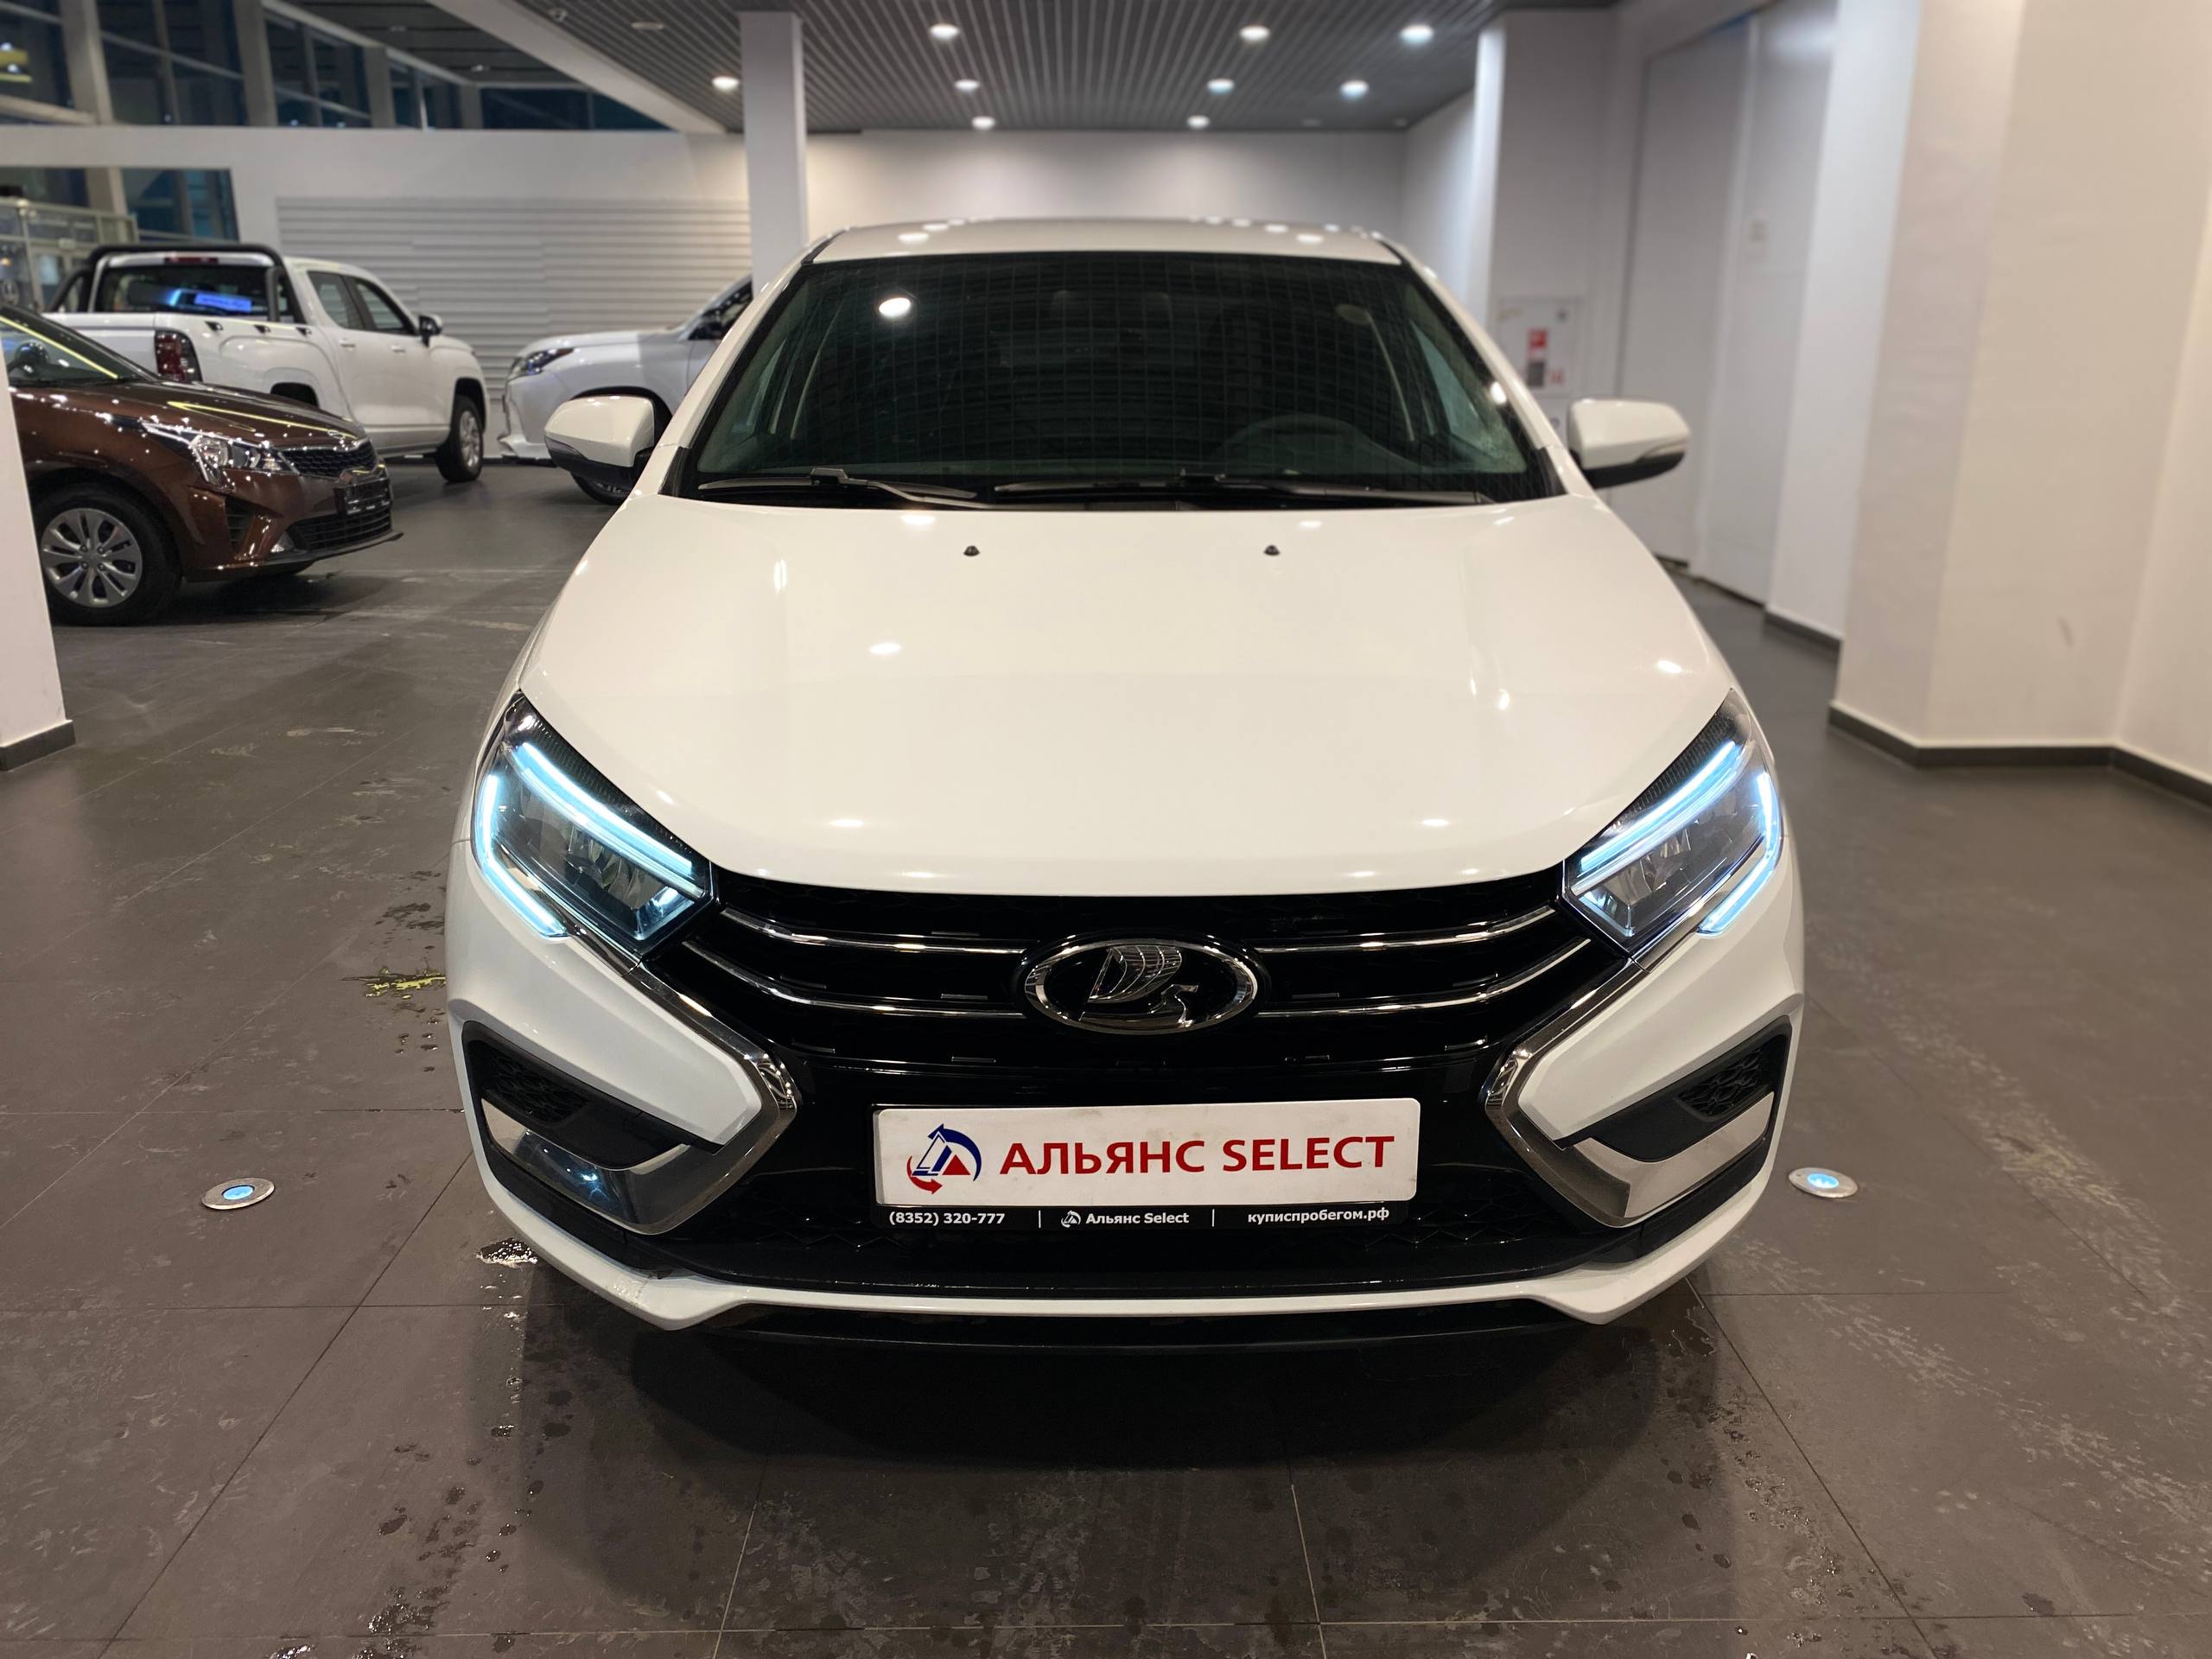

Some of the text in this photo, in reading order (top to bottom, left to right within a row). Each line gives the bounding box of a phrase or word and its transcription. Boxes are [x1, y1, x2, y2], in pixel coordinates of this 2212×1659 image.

[1000, 1135, 1396, 1176] АЛЬЯНС SELECT
[889, 1211, 1006, 1227] (8352) 320-777
[1085, 1211, 1190, 1224] Альянс Select
[1248, 1206, 1390, 1225] куписпробегом.рф
